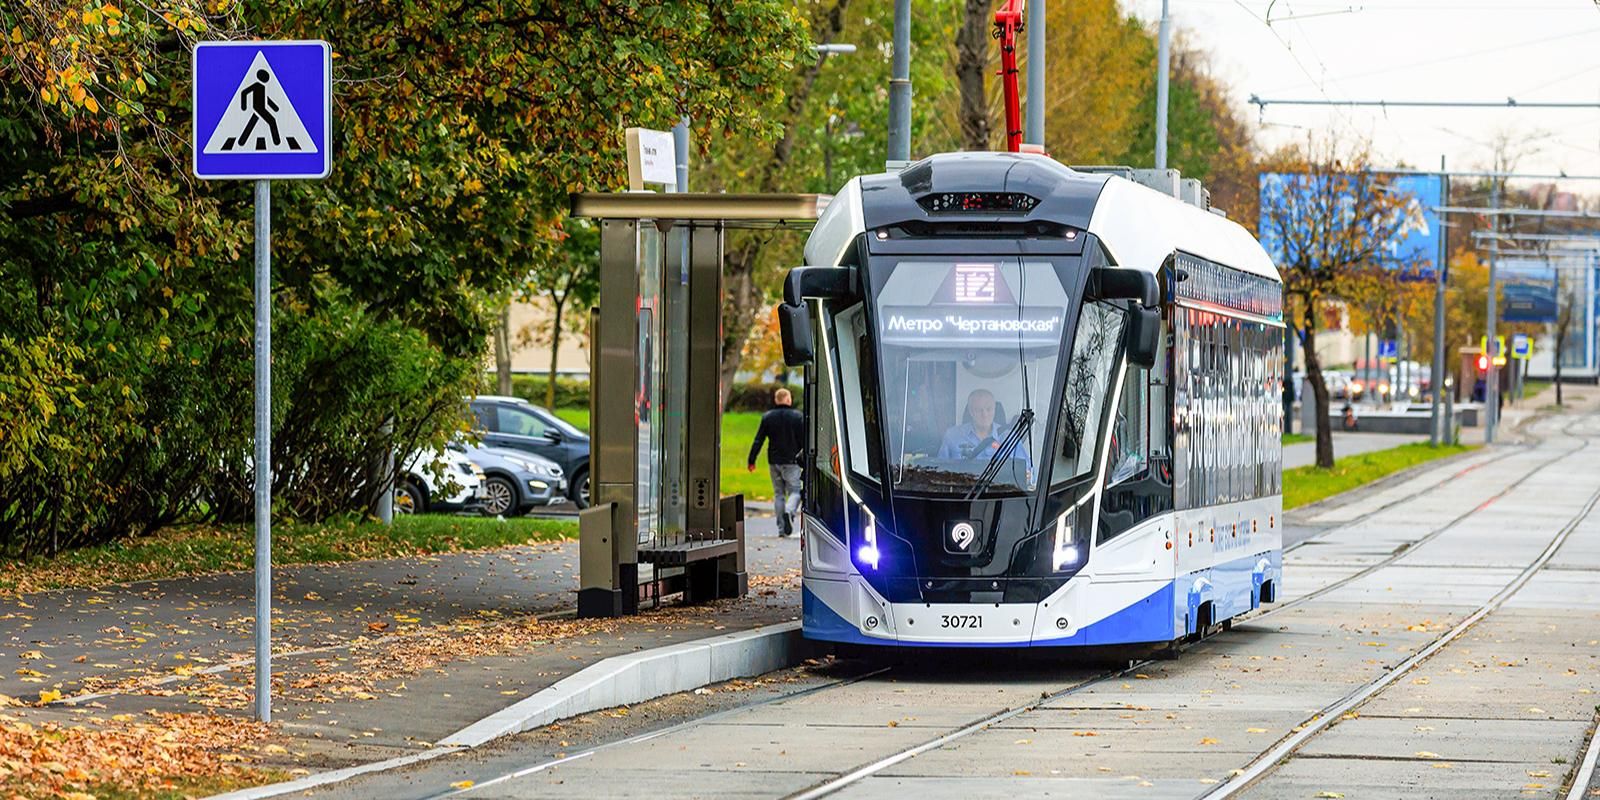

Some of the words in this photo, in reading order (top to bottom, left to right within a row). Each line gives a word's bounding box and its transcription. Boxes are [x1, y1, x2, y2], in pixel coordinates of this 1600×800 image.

[957, 272, 992, 297] Т2
[888, 315, 943, 334] Метро
[945, 315, 1059, 334] "Чертановская"
[941, 615, 983, 628] 30721
